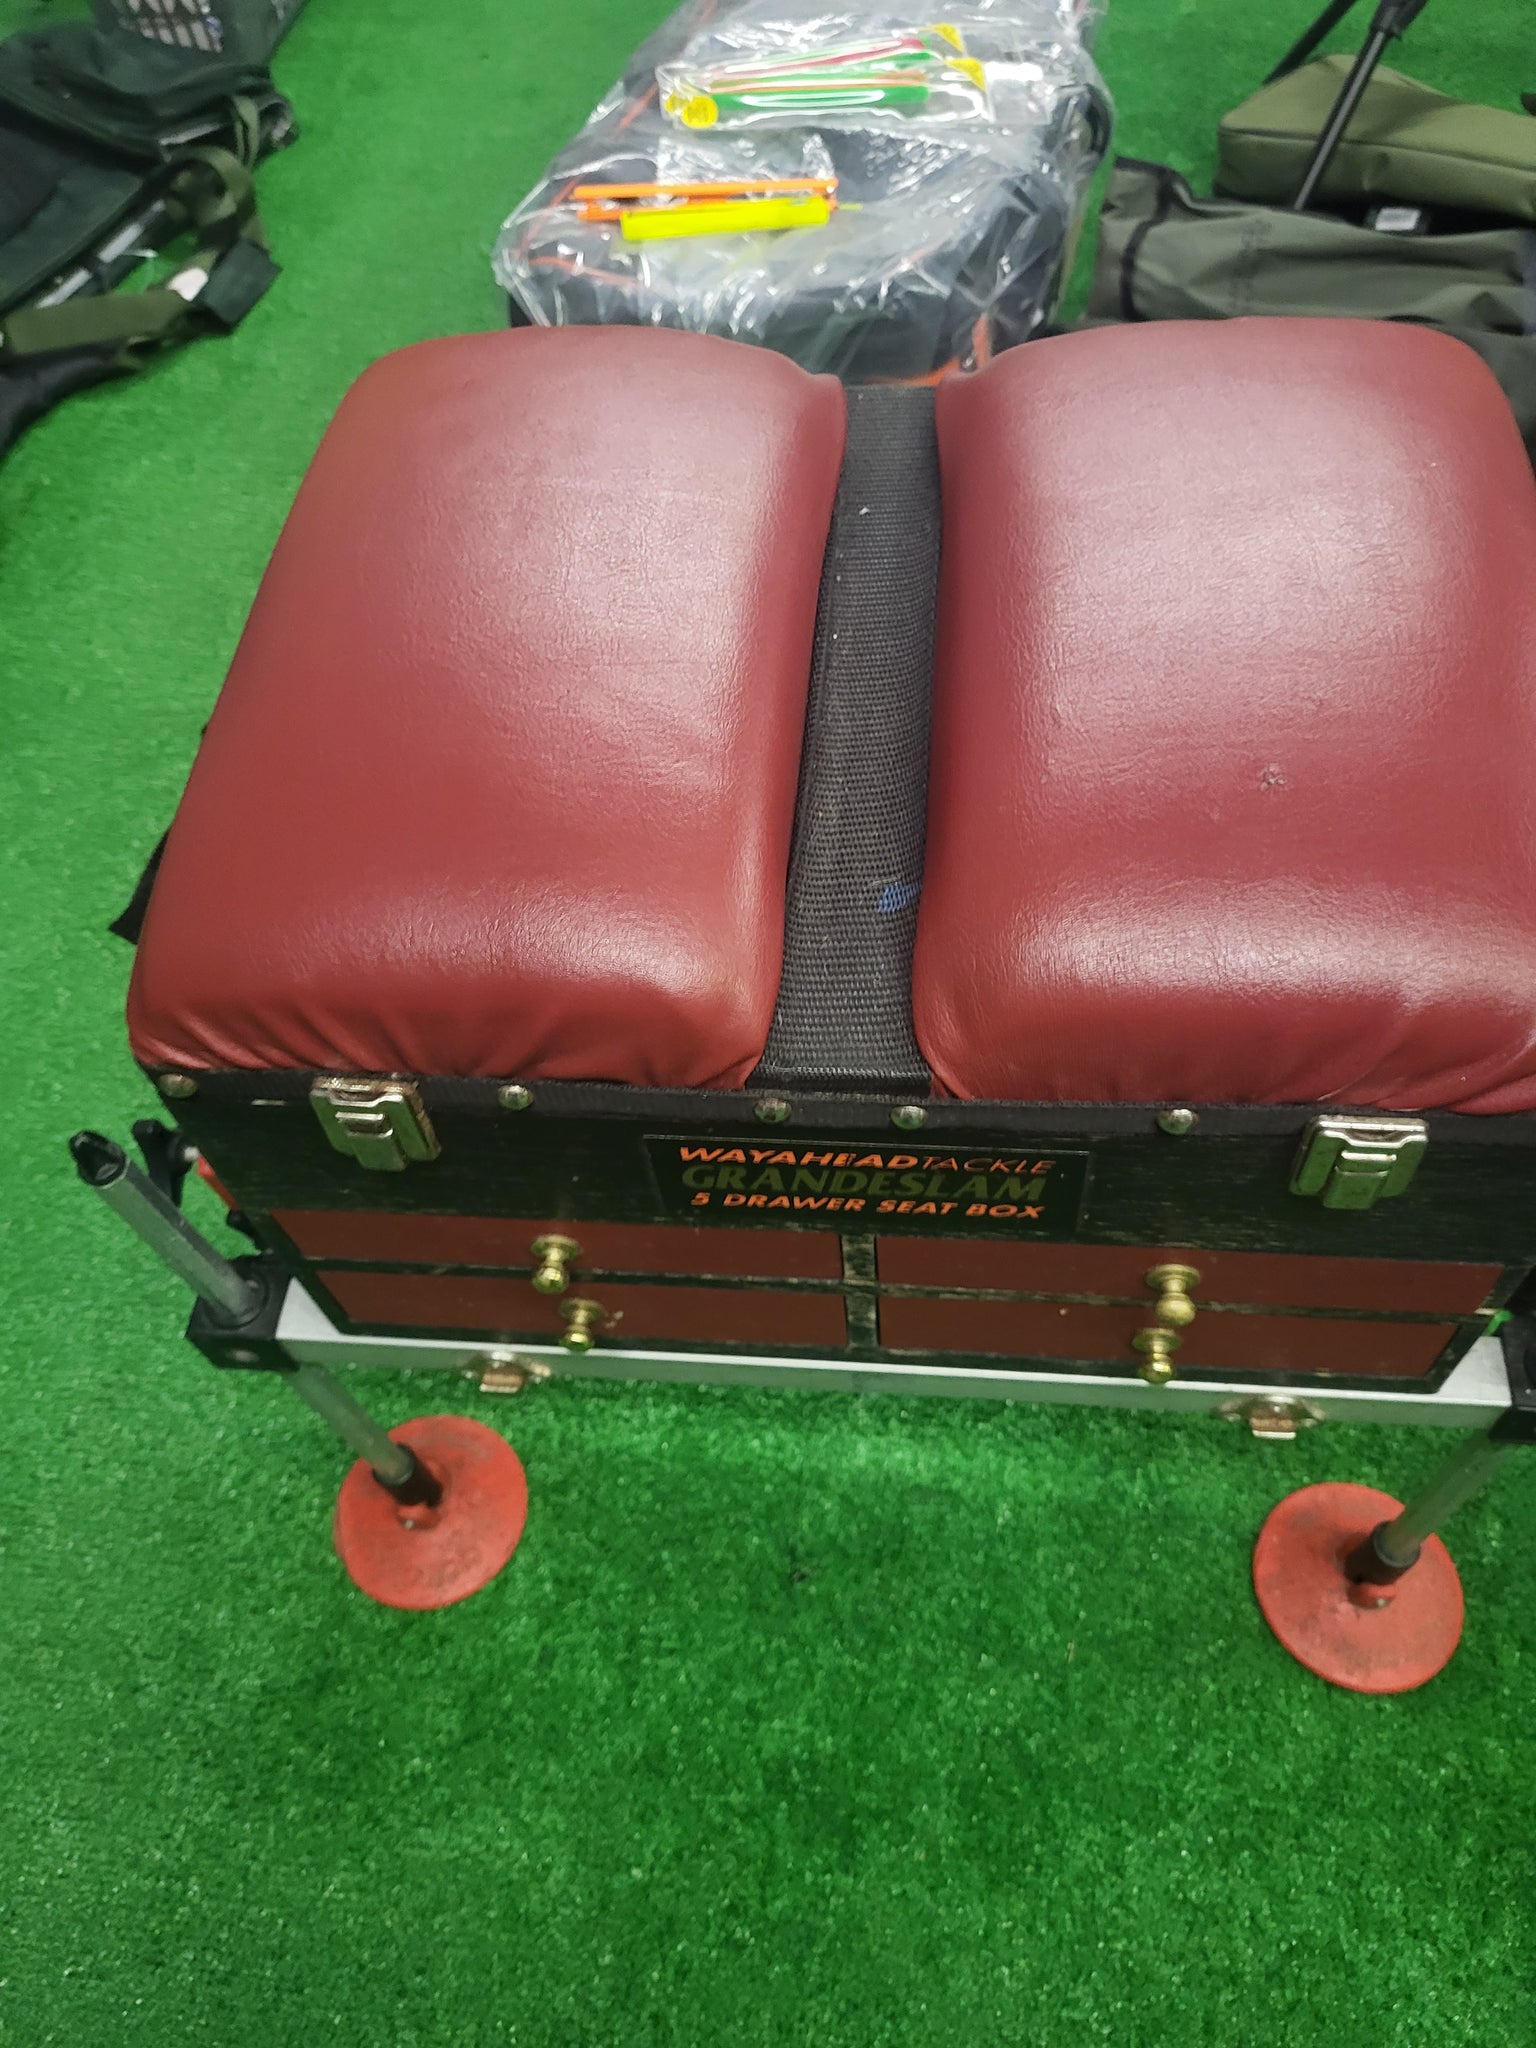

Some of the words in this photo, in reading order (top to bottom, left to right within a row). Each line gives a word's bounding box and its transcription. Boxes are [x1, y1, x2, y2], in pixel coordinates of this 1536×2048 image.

[691, 1191, 711, 1206] 5
[723, 1193, 866, 1212] DRAWER
[876, 1199, 958, 1216] SEAT
[965, 1203, 1046, 1219] BOX
